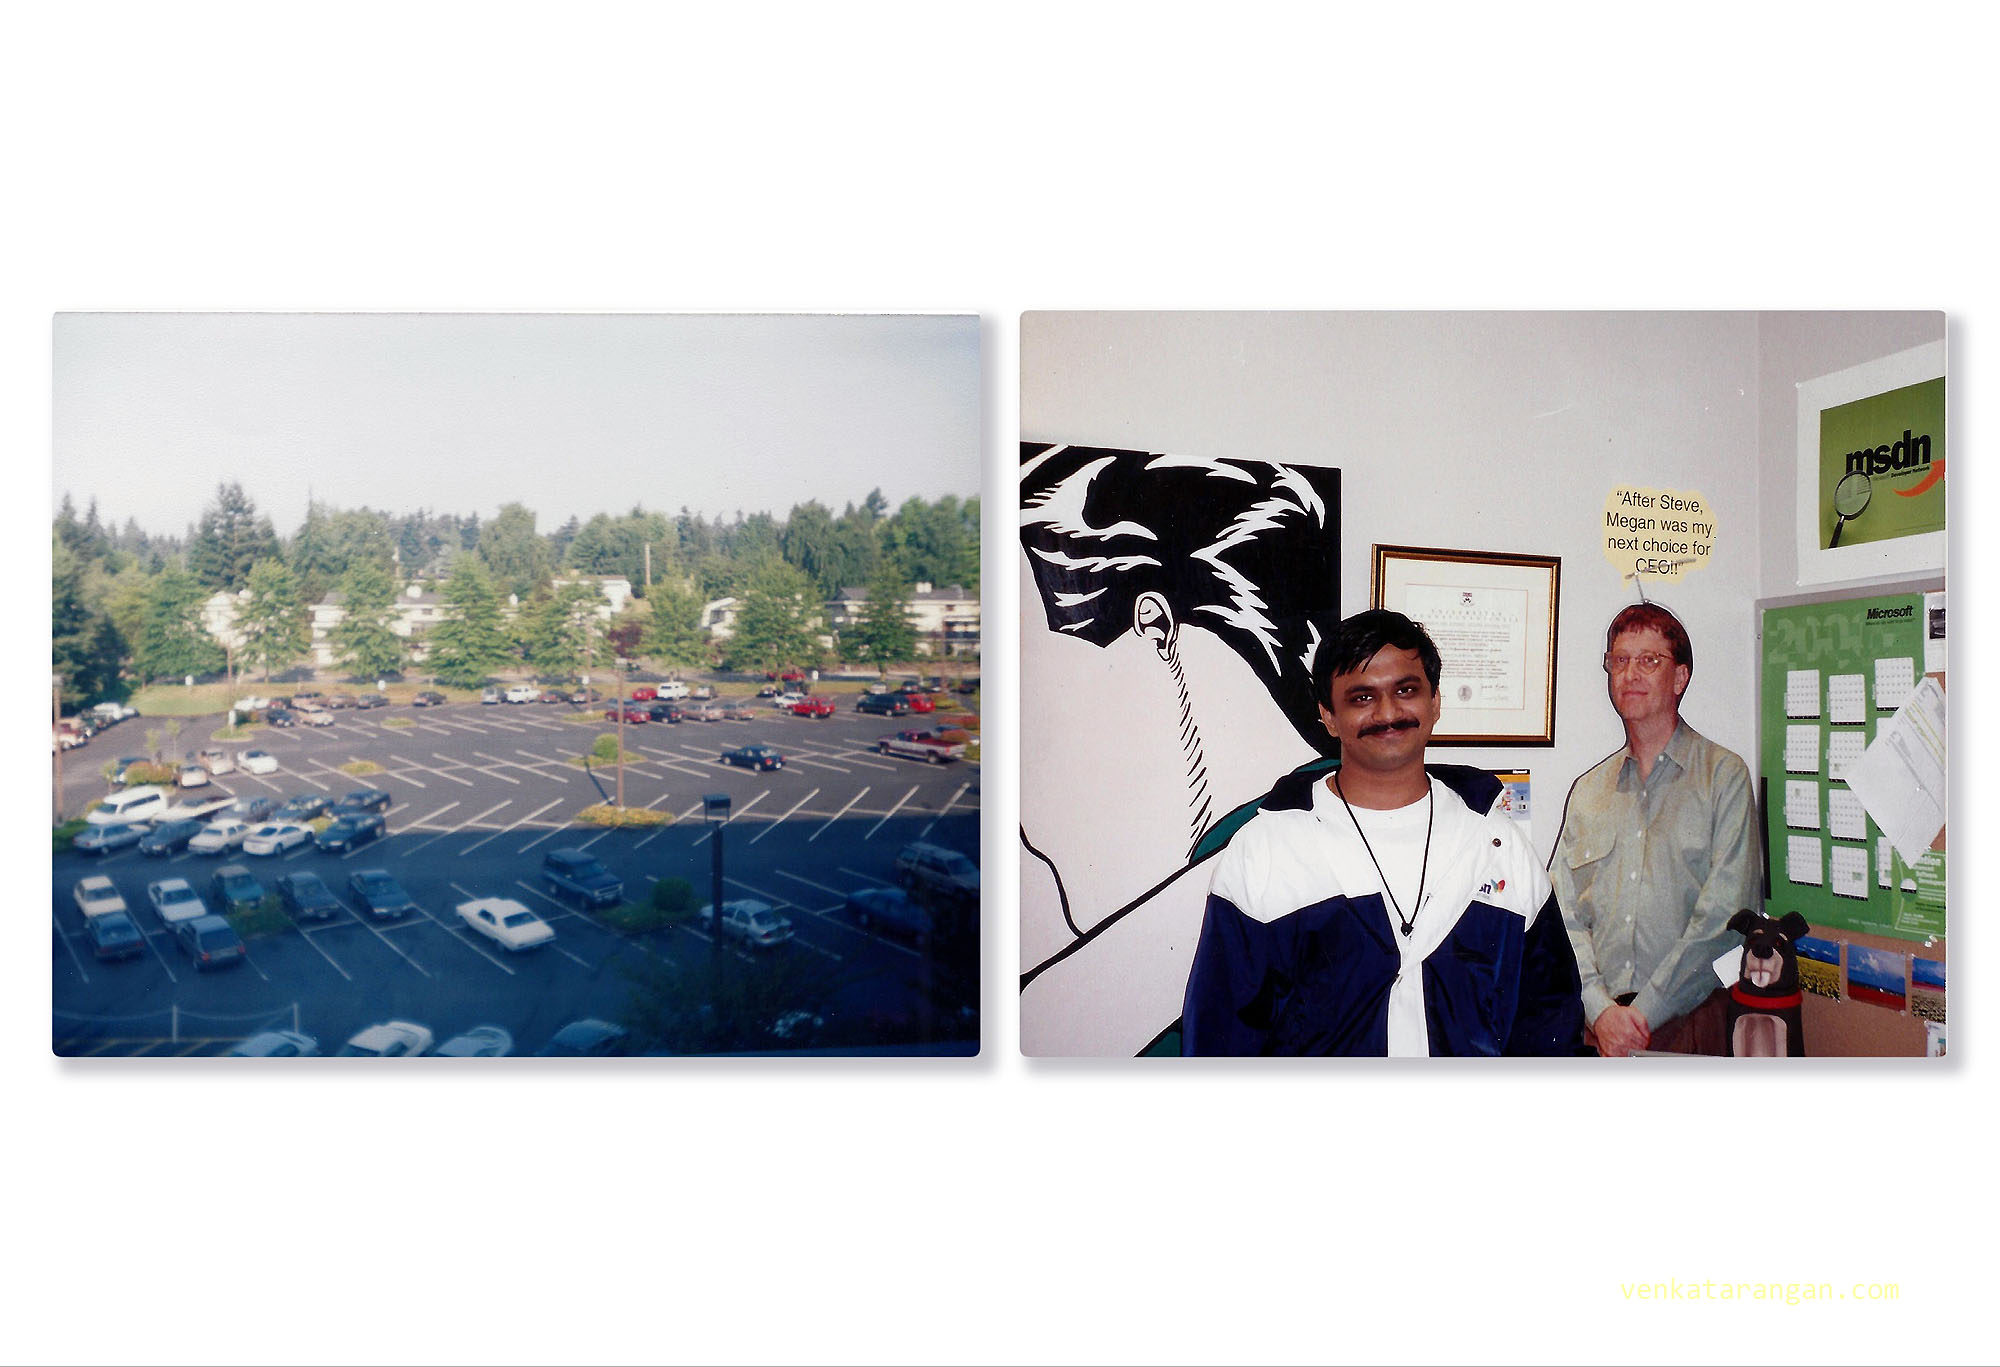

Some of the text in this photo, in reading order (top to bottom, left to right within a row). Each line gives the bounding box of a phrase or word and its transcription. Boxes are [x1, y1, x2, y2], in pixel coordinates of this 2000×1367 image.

[1846, 429, 1931, 476] msdn
[1660, 494, 1703, 515] Steve,
[1606, 511, 1713, 539] Megan was my
[1608, 537, 1711, 556] next choice for
[1866, 604, 1914, 620] Microsoft
